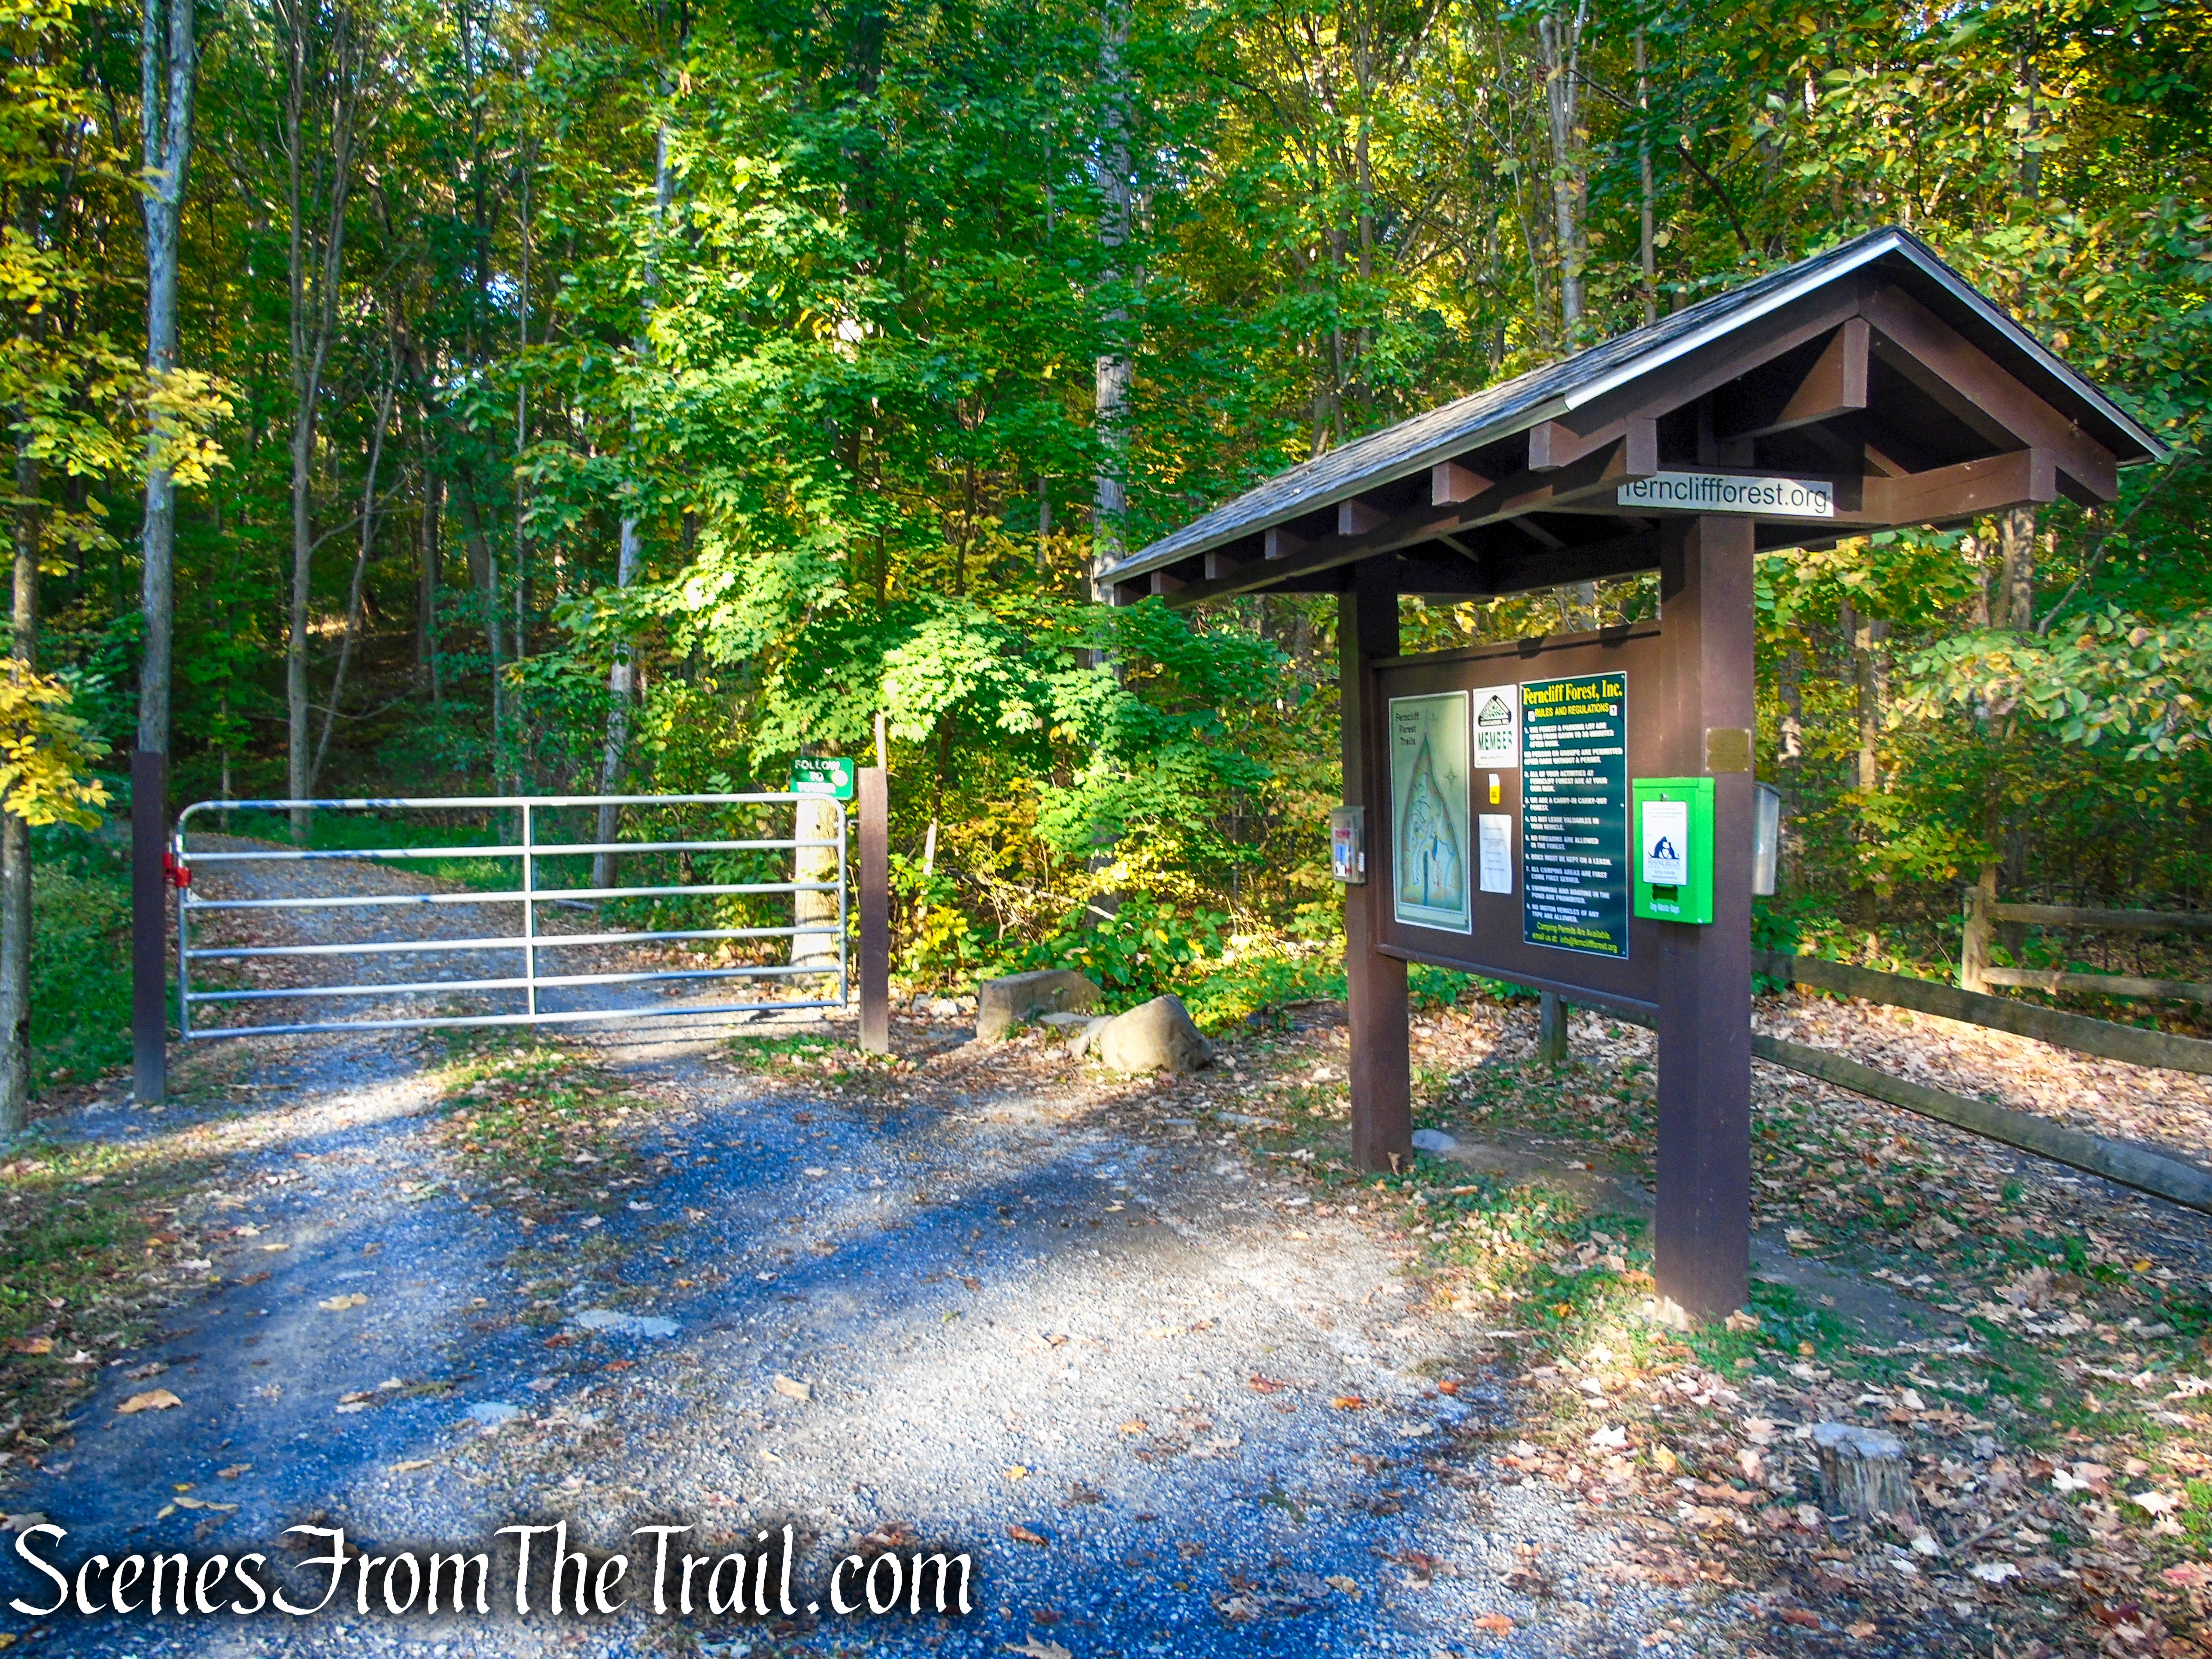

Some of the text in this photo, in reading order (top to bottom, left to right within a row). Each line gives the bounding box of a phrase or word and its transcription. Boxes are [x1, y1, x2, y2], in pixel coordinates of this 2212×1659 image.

[1523, 680, 1623, 705] Ferncliff Forest, Inc.
[1535, 703, 1609, 717] RULES AND REGULATIONS
[1399, 725, 1416, 733] Forest
[1479, 731, 1512, 750] MEMBER
[1592, 747, 1623, 755] PERMITTED
[794, 760, 840, 771] FOLLOW
[809, 771, 824, 782] TO
[1540, 866, 1563, 875] CAMPING
[1569, 888, 1592, 897] BOATING
[1556, 906, 1580, 916] VEHICLES
[1554, 914, 1578, 923] ALLOWED.
[1537, 922, 1558, 933] Camping
[1558, 924, 1576, 935] Permits
[1577, 927, 1586, 936] Are
